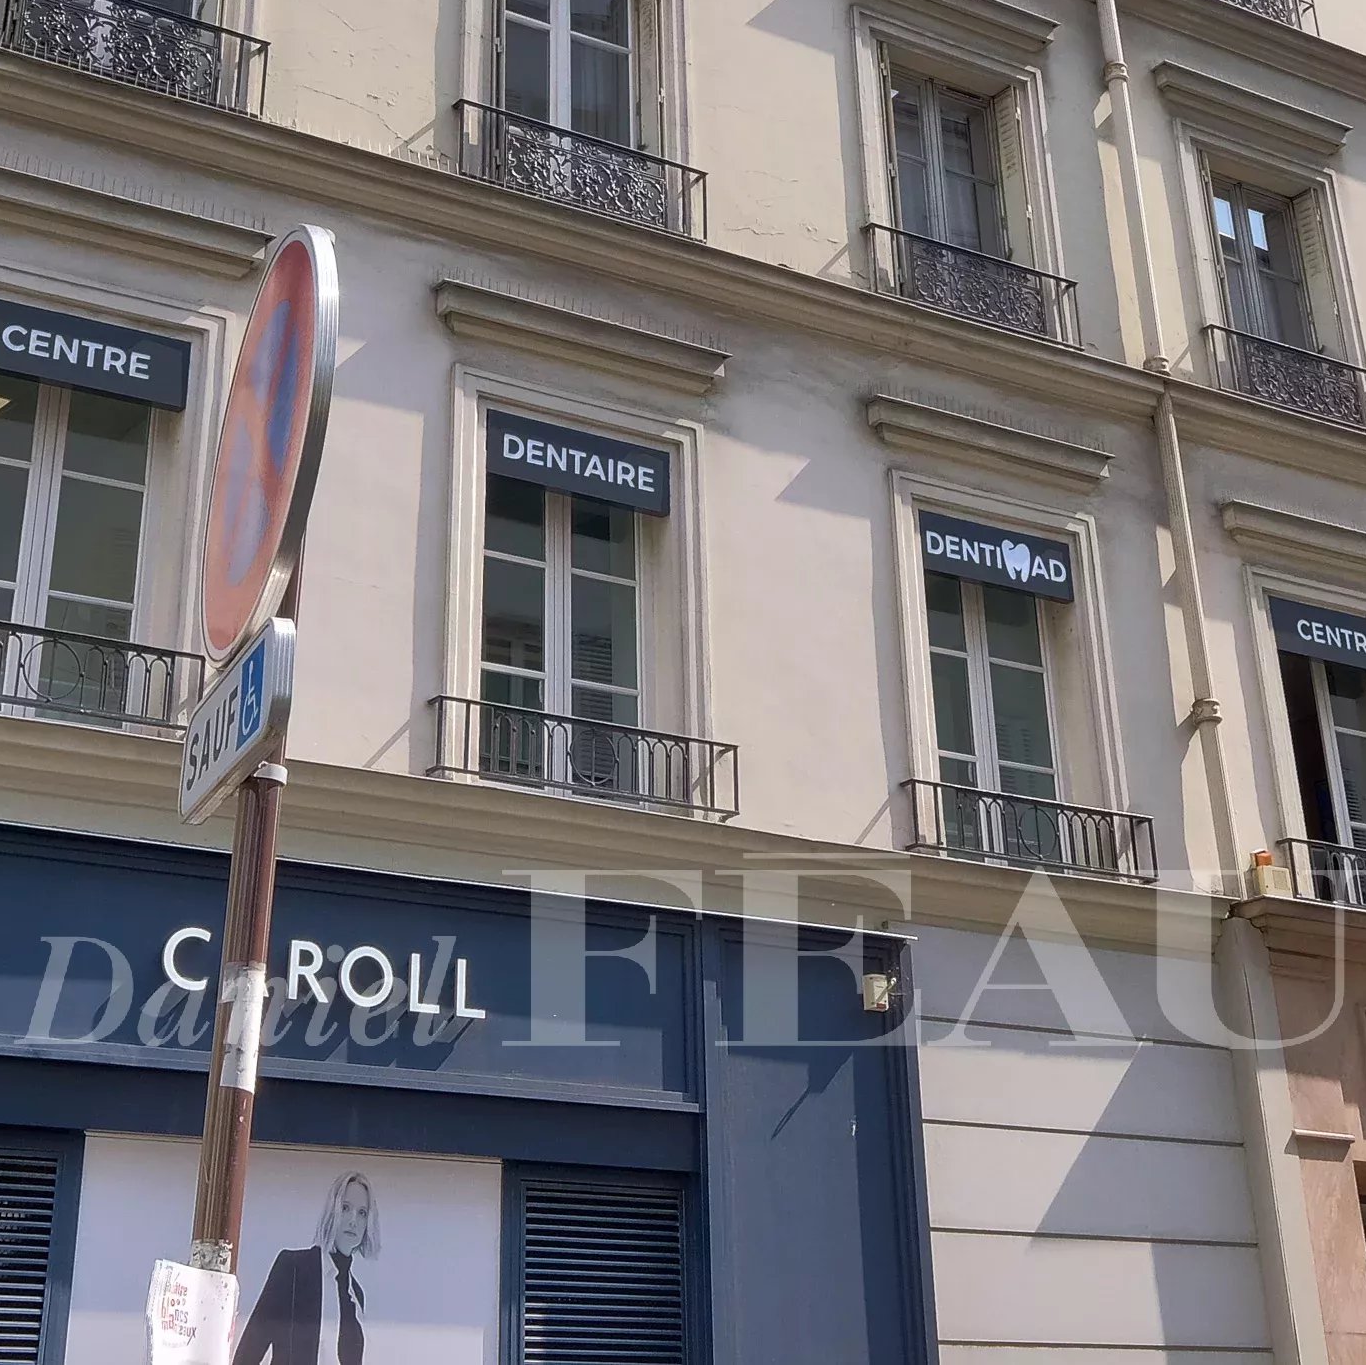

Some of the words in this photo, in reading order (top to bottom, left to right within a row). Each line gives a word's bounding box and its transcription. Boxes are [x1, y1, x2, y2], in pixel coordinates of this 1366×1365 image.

[1, 324, 151, 380] CENTRE
[503, 433, 655, 493] DENTAIRE
[186, 684, 239, 792] SAUF
[162, 927, 487, 1020] CROLL
